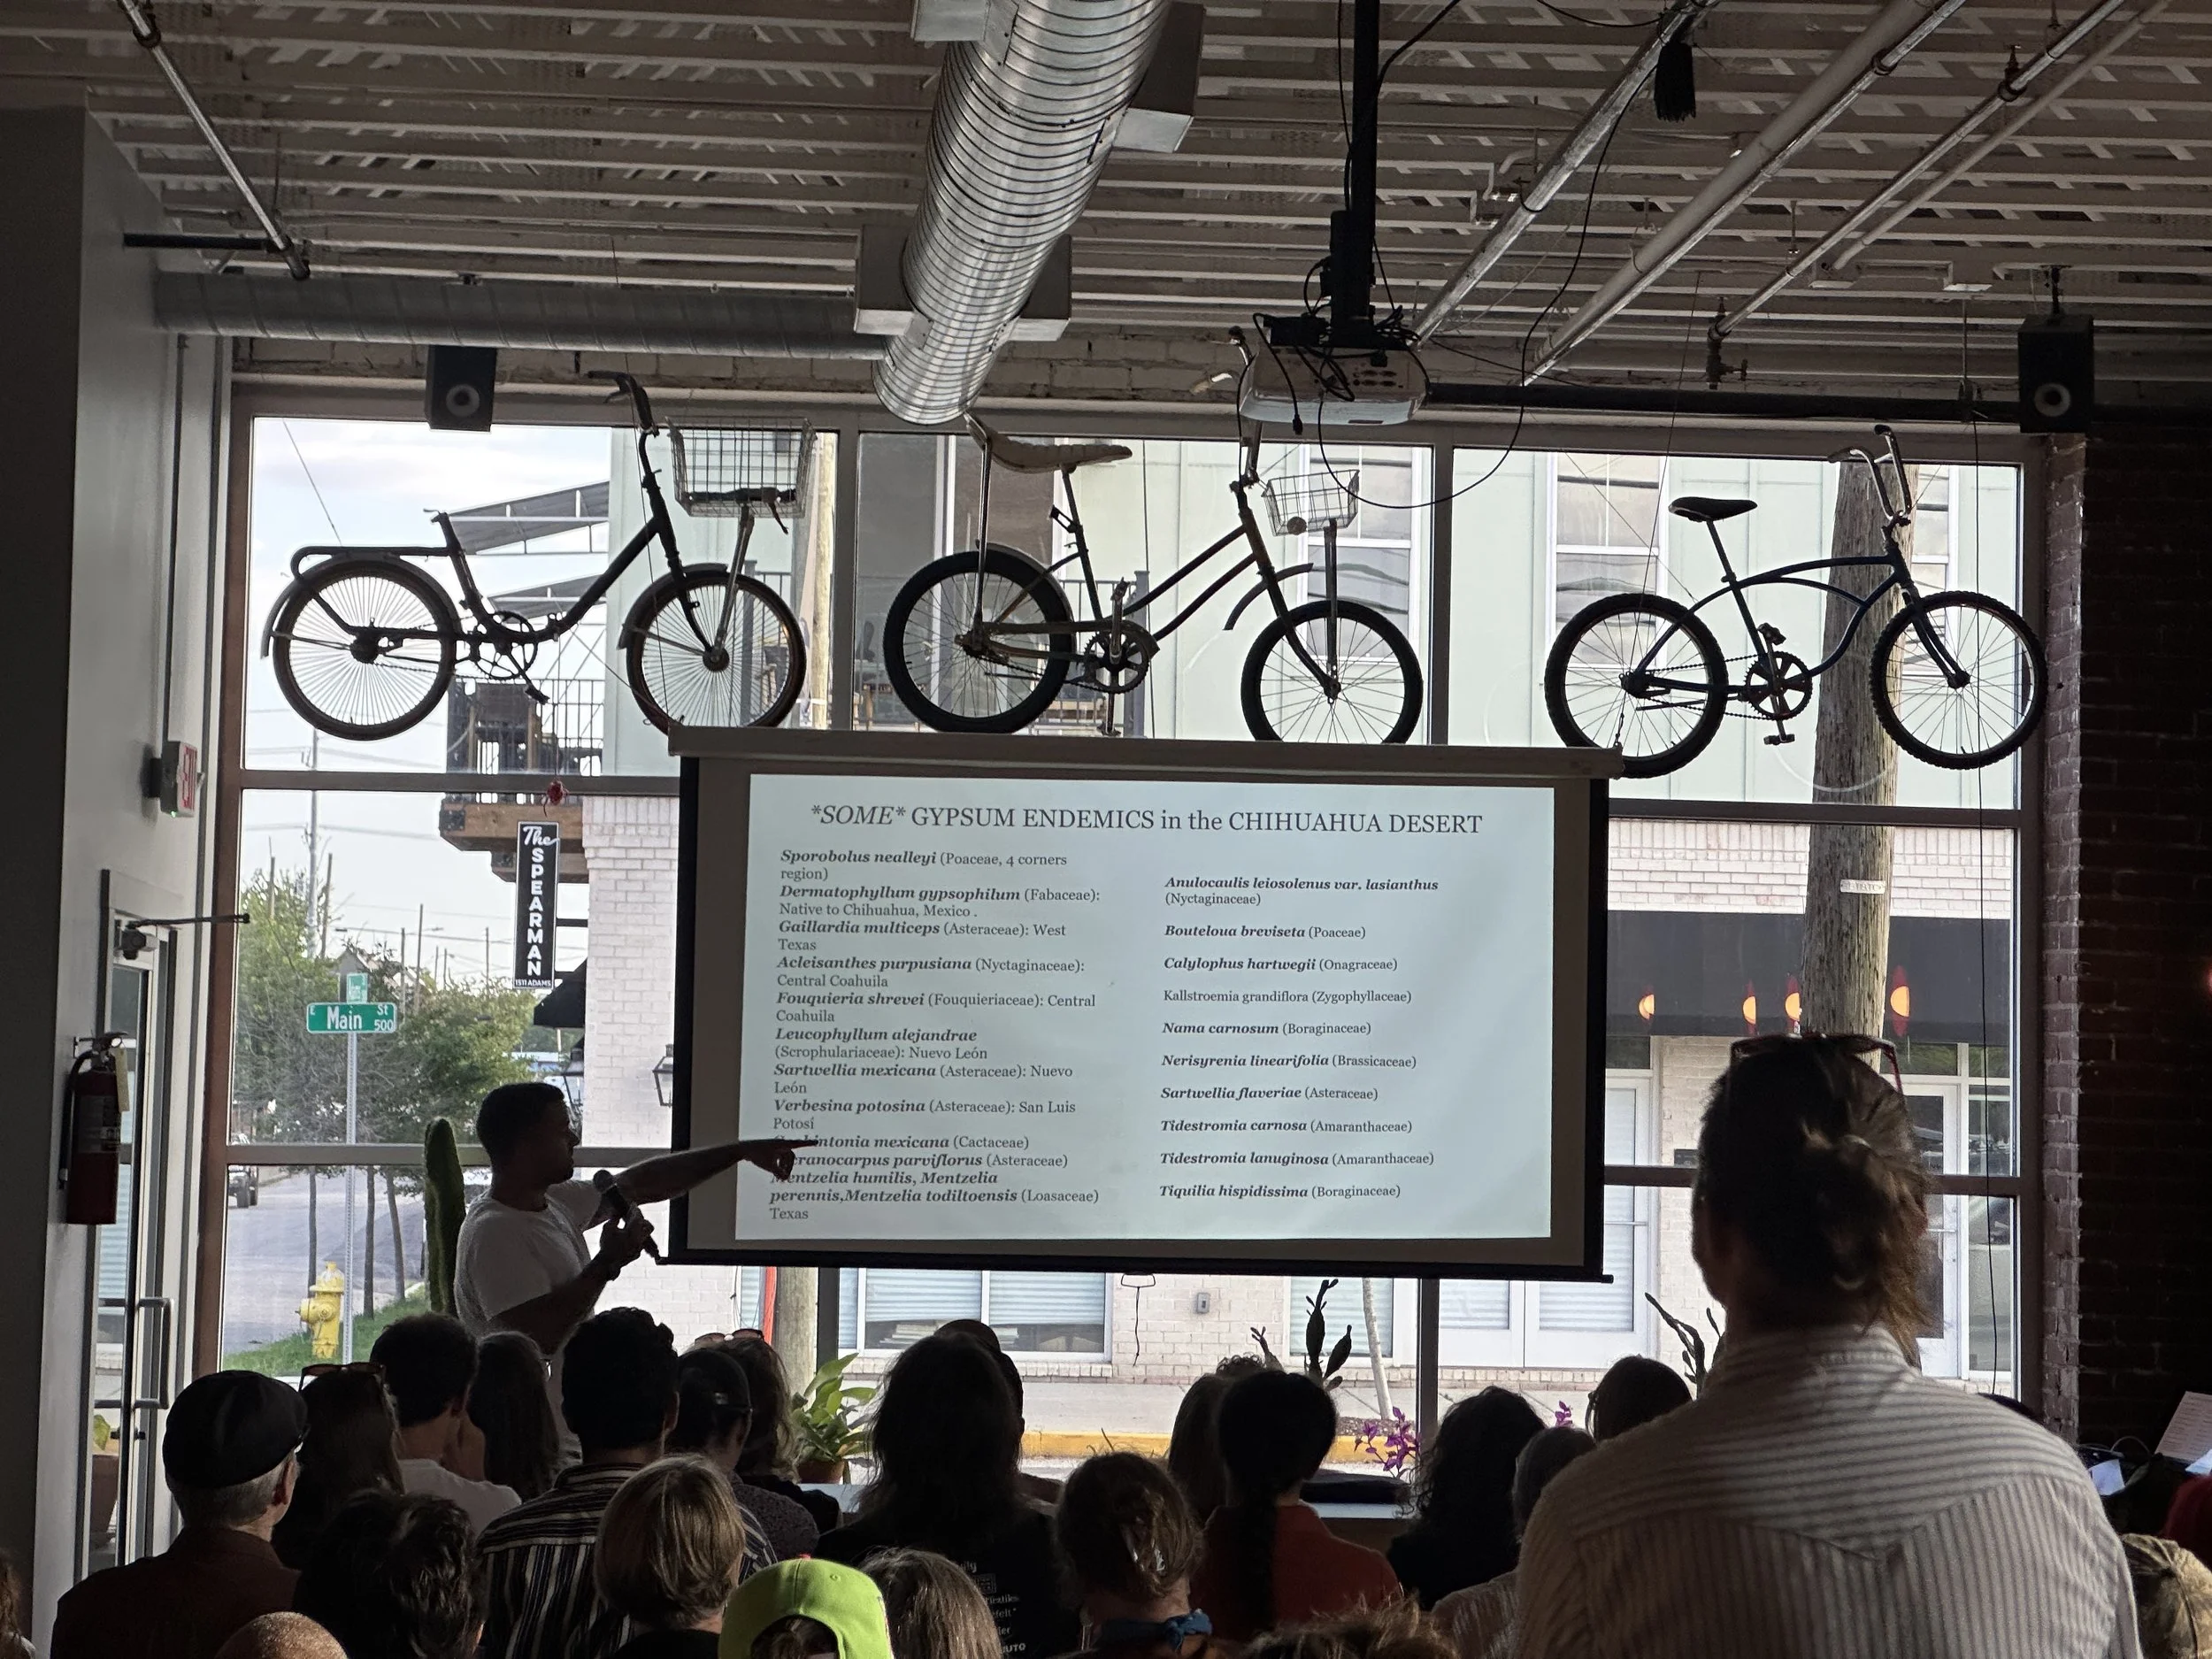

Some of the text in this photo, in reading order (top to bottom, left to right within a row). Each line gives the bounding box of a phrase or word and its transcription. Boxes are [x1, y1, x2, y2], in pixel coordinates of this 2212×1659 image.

[911, 807, 1016, 827] GYPSUM
[1023, 809, 1154, 829] ENDEMICS
[1160, 810, 1182, 829] in
[1187, 810, 1222, 831] the
[1229, 811, 1383, 833] CHIHUAHUA
[1388, 814, 1483, 833] DESERT
[523, 826, 560, 846] The
[780, 849, 1067, 867] Sporobolus nealleyi (Poaceae, 4 corners
[781, 867, 828, 882] region)
[1164, 876, 1439, 890] Anulocaulis leiosolenus var. lasianthus
[780, 885, 1100, 902] Dermatophyllum gypsophilum (Fabaceae):
[1165, 892, 1261, 907] (Nyctaginaceae)
[527, 847, 544, 977] SPEARMAN
[780, 902, 971, 918] Native to Chihuahua, Mexico
[779, 920, 1065, 938] Gaillardia multiceps (Asteraceae): West
[1164, 925, 1366, 940] Bouteloua breviseta (Poaceae)
[778, 939, 817, 951] Texas
[776, 956, 1084, 974] Acleisanthes purpusiana (Nyctaginaceae):
[1164, 957, 1397, 972] Calylophus hartwegii (Onagraceae)
[777, 974, 888, 987] Central Coahuila
[776, 992, 1095, 1008] Fouquieria shrevei (Fouquieriaceae): Central
[1164, 989, 1411, 1004] Kallstroemia grandiflora (Zygophyllaceae)
[310, 1004, 388, 1031] E Main St
[776, 1009, 834, 1022] Coahuila
[373, 1019, 395, 1031] 500
[1162, 1022, 1371, 1037] Nama carnosum (Boraginaceae)
[775, 1027, 977, 1044] Leucophyllum alejandrae
[775, 1045, 987, 1061] (Scrophulariaceae): Nuevo León
[1161, 1054, 1417, 1069] Nerisyrenia linearifolia (Brassicaceae)
[773, 1064, 1072, 1079] Sartwellia mexicana (Asteraceae): Nuevo
[774, 1080, 807, 1094] León
[1160, 1087, 1378, 1102] Sartwellia flaveriae (Asteraceae)
[774, 1099, 1076, 1115] Verbesina potosina (Asteraceae): San Luis
[773, 1117, 814, 1129] Potosí
[1161, 1119, 1412, 1133] Tidestromia carnosa (Amaranthaceae)
[774, 1134, 1029, 1150] intonia mexicana (Cactaceae)
[795, 1154, 1068, 1169] ranocarpus parviflorus (Asteraceae)
[1160, 1151, 1434, 1167] Tidestromia lanuginosa (Amaranthaceae)
[853, 1171, 917, 1187] humilis,
[919, 1171, 998, 1184] Mentzelia
[926, 1188, 1018, 1202] todiltoensis
[1021, 1189, 1099, 1204] (Loasaceae)
[1159, 1184, 1401, 1200] Tiquilia hispidissima (Boraginaceae)
[769, 1207, 809, 1219] Texas
